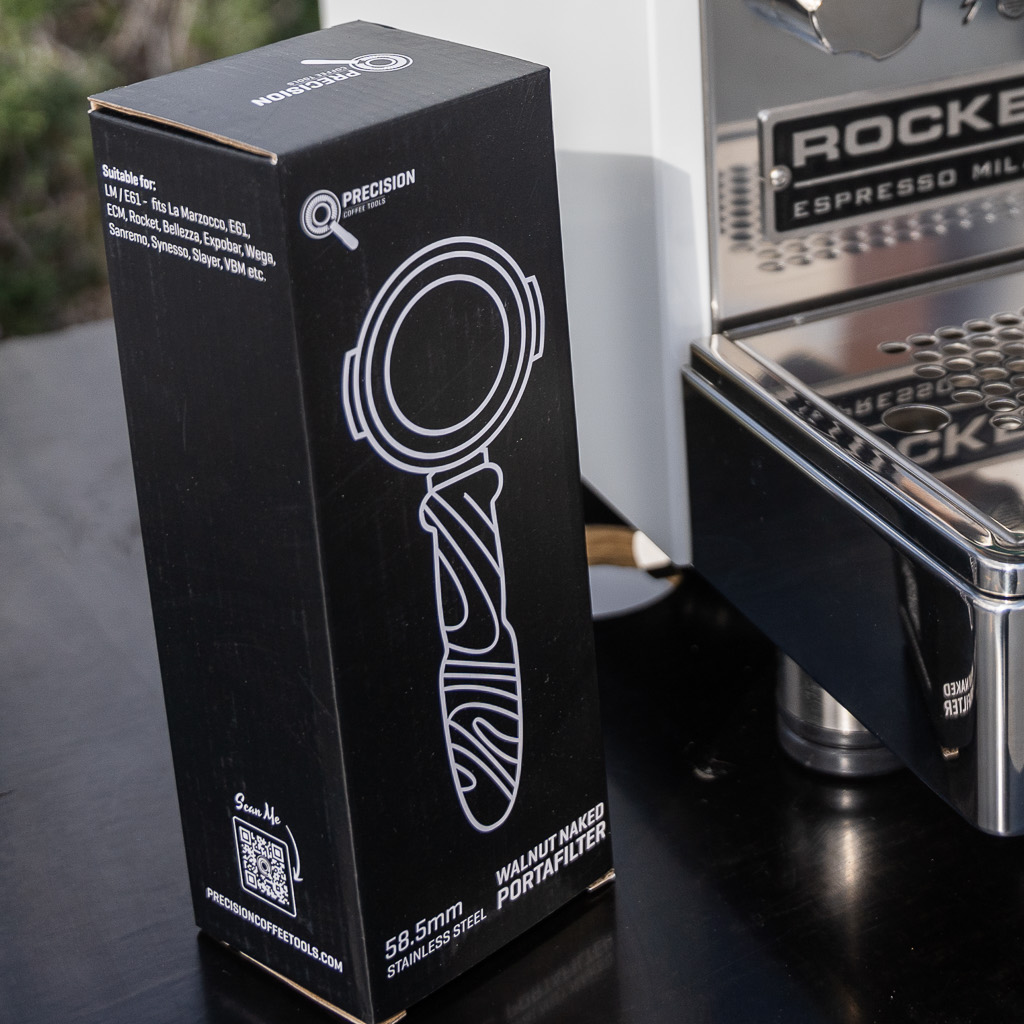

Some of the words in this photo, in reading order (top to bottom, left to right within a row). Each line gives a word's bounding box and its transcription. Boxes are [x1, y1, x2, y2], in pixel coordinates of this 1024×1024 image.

[251, 70, 361, 107] PRECISION
[102, 164, 138, 186] Suitable
[139, 175, 157, 191] for:
[342, 168, 416, 208] PRECISION
[793, 168, 957, 218] ESPRESSO
[104, 184, 117, 198] LM
[124, 189, 142, 206] E61
[151, 197, 167, 214] fits
[168, 202, 179, 217] La
[181, 205, 228, 233] Marzocco,
[228, 219, 251, 239] E61,
[106, 203, 128, 222] ECM,
[129, 210, 161, 232] Rocket,
[163, 219, 203, 245] Bellezza,
[203, 231, 244, 257] Expobar,
[244, 243, 277, 267] Wega,
[343, 205, 366, 219] COFFEE
[367, 197, 386, 210] TOOLS
[108, 222, 151, 248] Sanremo,
[151, 236, 192, 261] Synesso,
[192, 247, 224, 270] Slayer,
[224, 257, 247, 276] VBM
[247, 266, 267, 282] etc.
[234, 792, 262, 817] Scan
[262, 802, 281, 825] Me
[496, 834, 557, 885] WALNUT
[559, 802, 605, 846] NAKED
[497, 821, 606, 910] PORTAFILTER
[206, 887, 343, 973] PRECISIONCOFFEETOOLS.COM
[385, 901, 463, 960] 58.5mm
[387, 931, 450, 979] STAINLESS
[453, 908, 487, 938] STEEL
